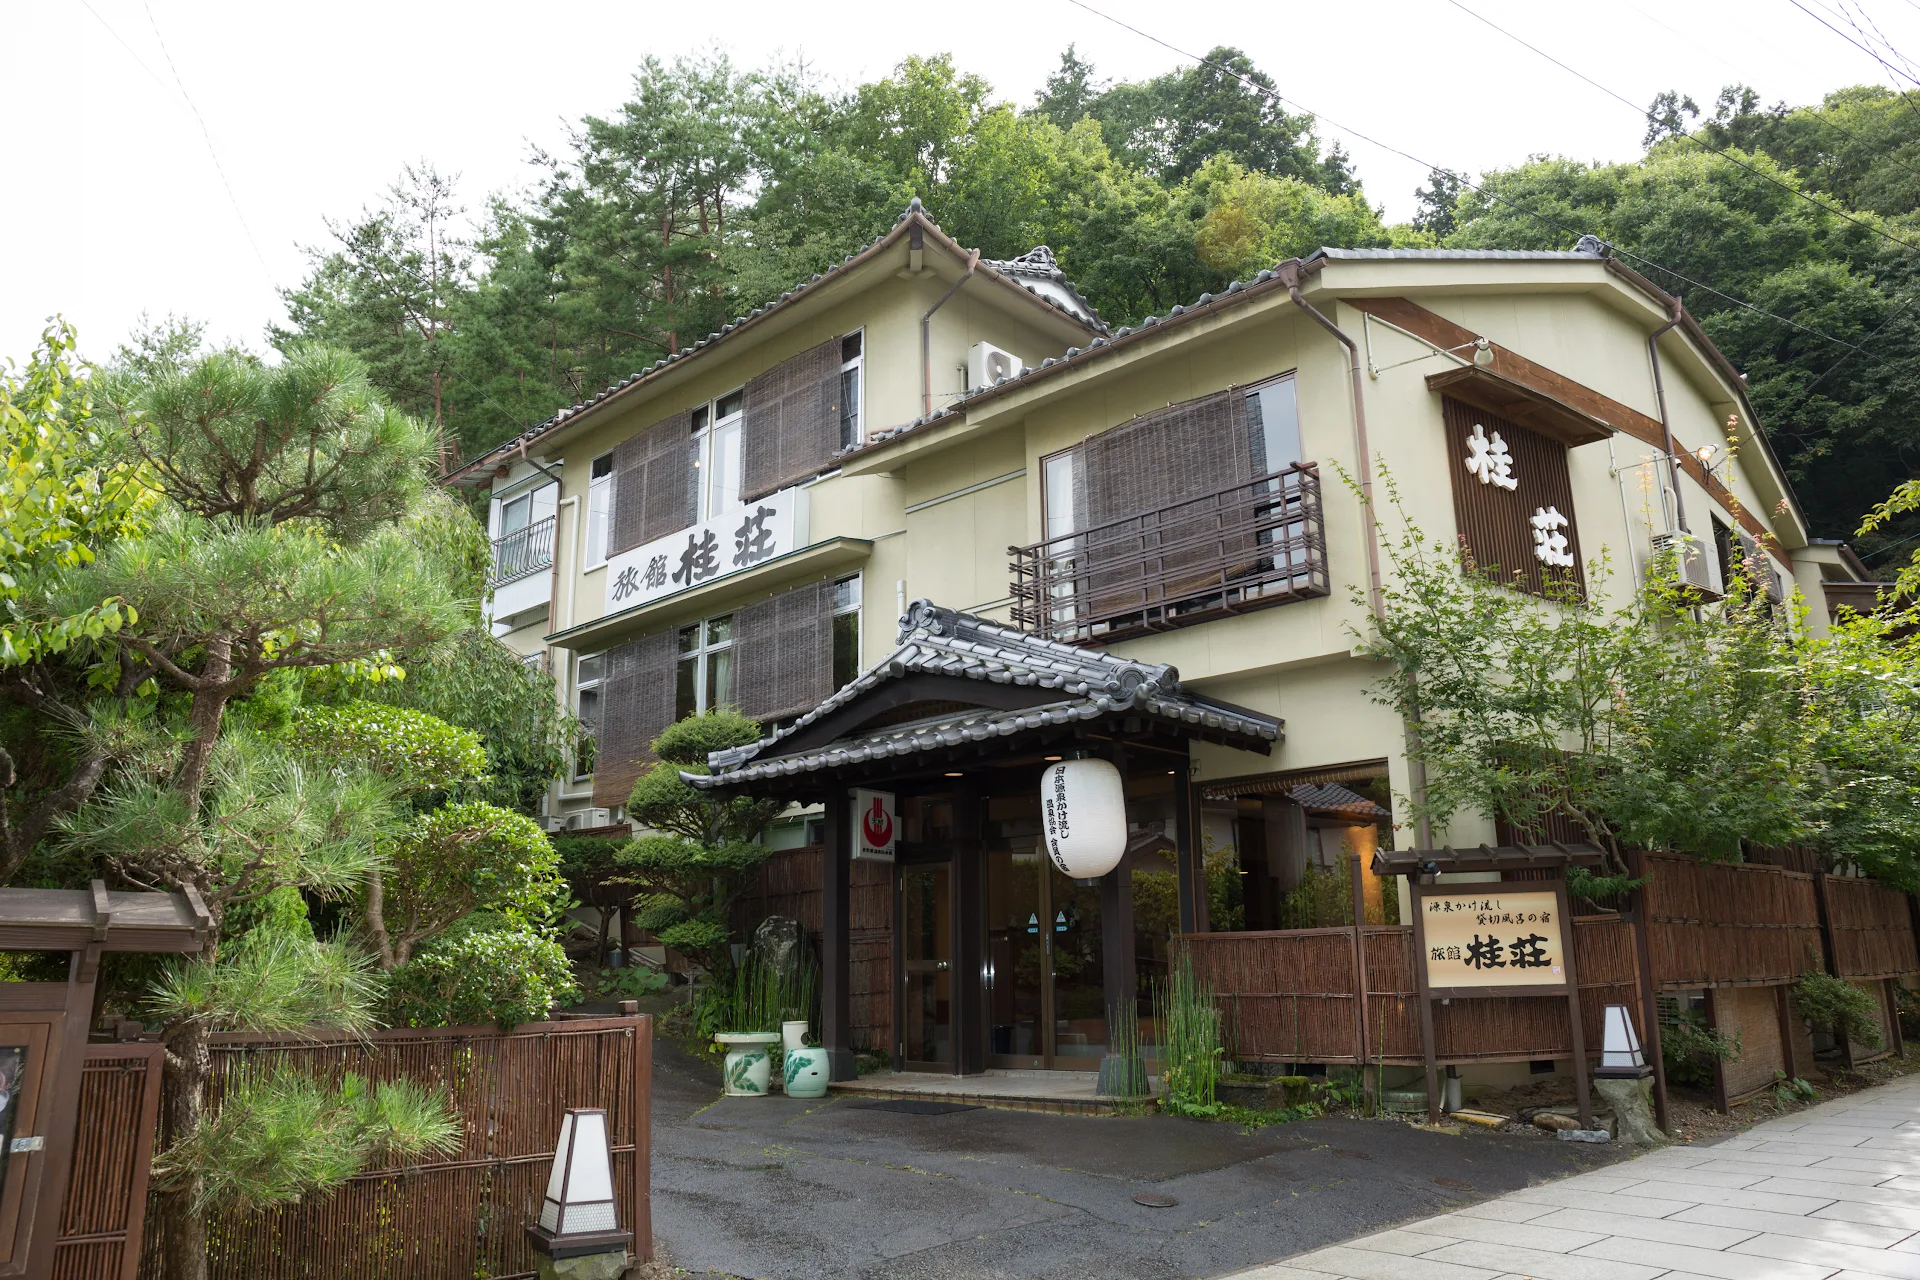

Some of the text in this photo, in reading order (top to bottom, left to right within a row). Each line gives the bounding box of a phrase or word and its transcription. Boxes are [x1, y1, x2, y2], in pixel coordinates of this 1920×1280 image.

[1429, 900, 1502, 912] 源泉かけ流し
[1476, 911, 1551, 925] 貸切風呂の宿
